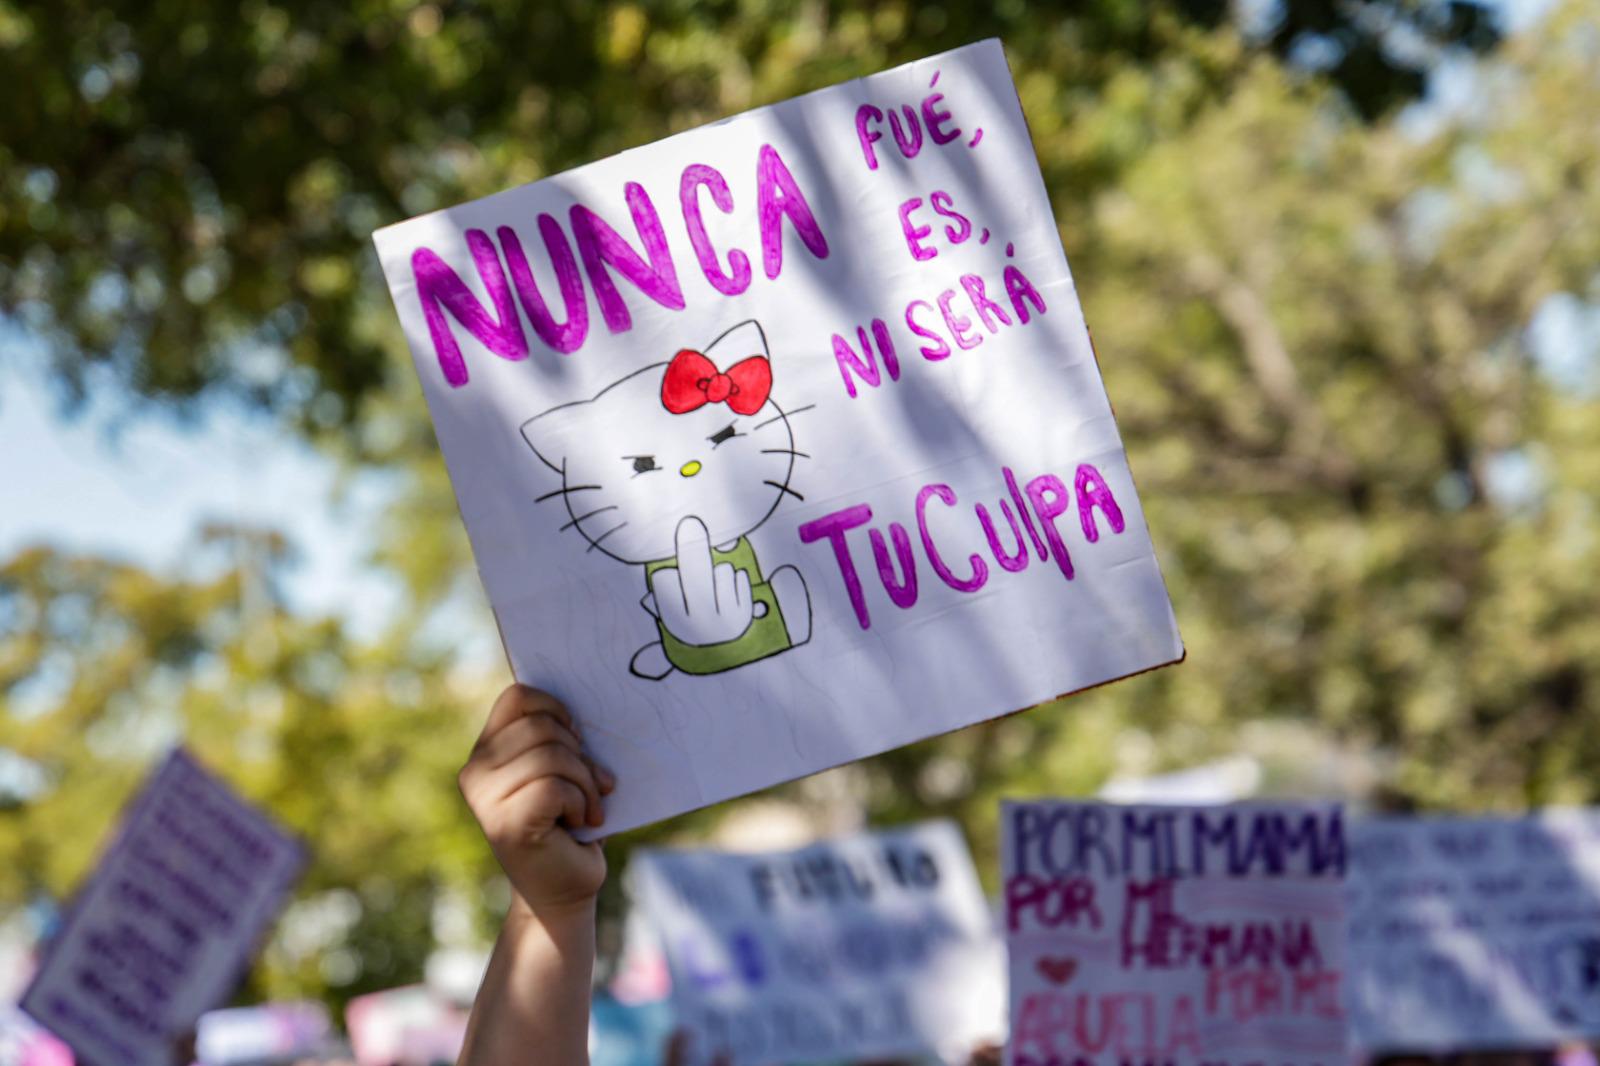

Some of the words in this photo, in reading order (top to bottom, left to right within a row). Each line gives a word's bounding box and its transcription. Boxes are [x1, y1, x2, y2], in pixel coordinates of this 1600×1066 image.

[854, 72, 985, 172] FUÉ,
[899, 190, 992, 262] ES,
[410, 142, 832, 390] NUNCA
[831, 317, 901, 399] NI
[904, 242, 1048, 363] SERÁ
[798, 503, 919, 631] TU
[1010, 805, 1115, 878] POR
[1121, 809, 1183, 879] MI
[1003, 873, 1103, 933] POR
[1119, 912, 1325, 970] HERMANA
[1010, 991, 1205, 1059] ABUELA
[1206, 968, 1286, 1024] POR
